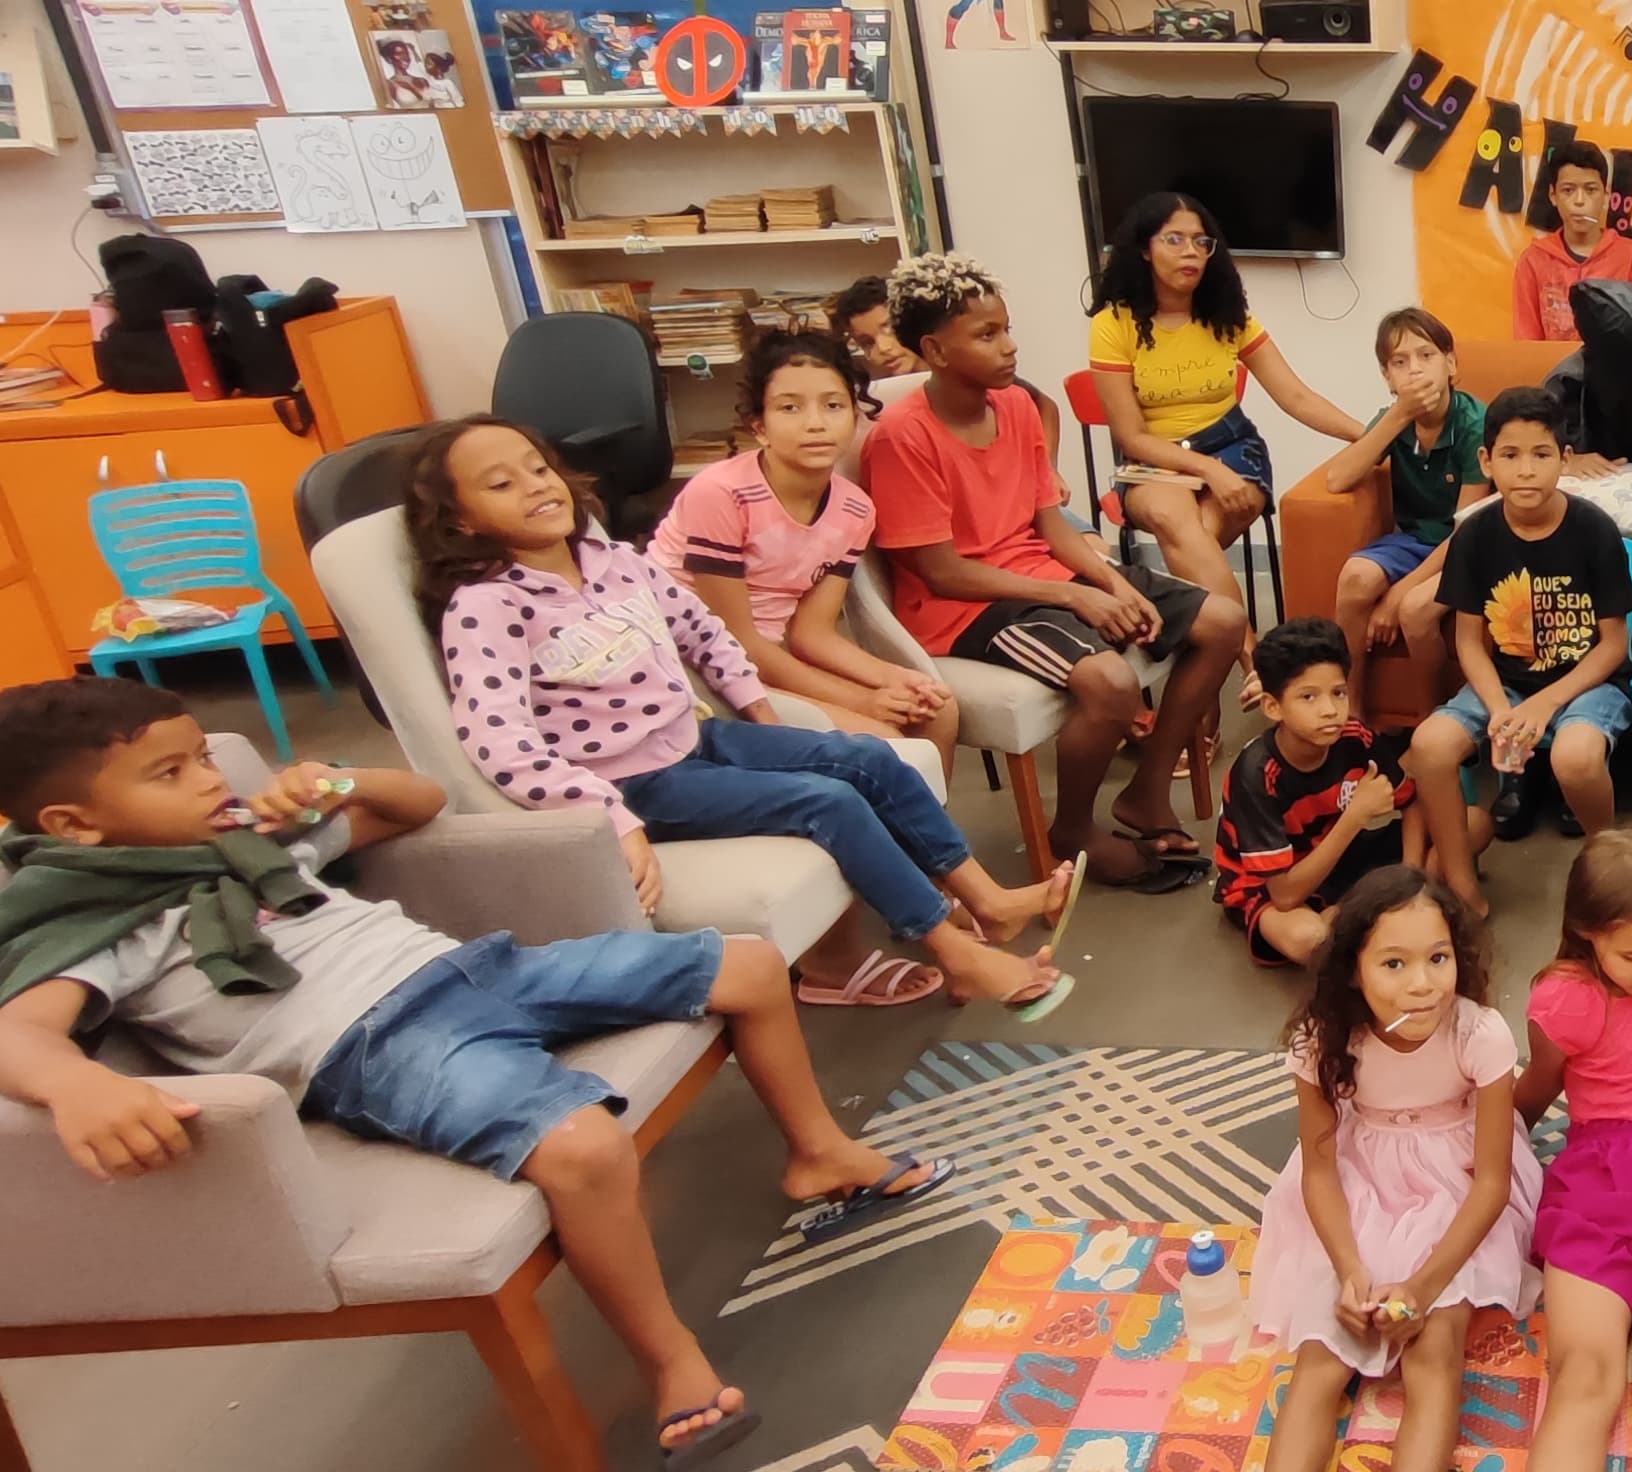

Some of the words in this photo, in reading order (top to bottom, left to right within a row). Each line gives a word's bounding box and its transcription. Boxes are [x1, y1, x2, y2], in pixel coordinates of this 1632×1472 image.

[1533, 576, 1562, 593] QUE
[1533, 594, 1553, 611] EU
[1556, 592, 1593, 610] SEJA
[1535, 610, 1578, 629] TODO
[1536, 627, 1580, 647] COMO
